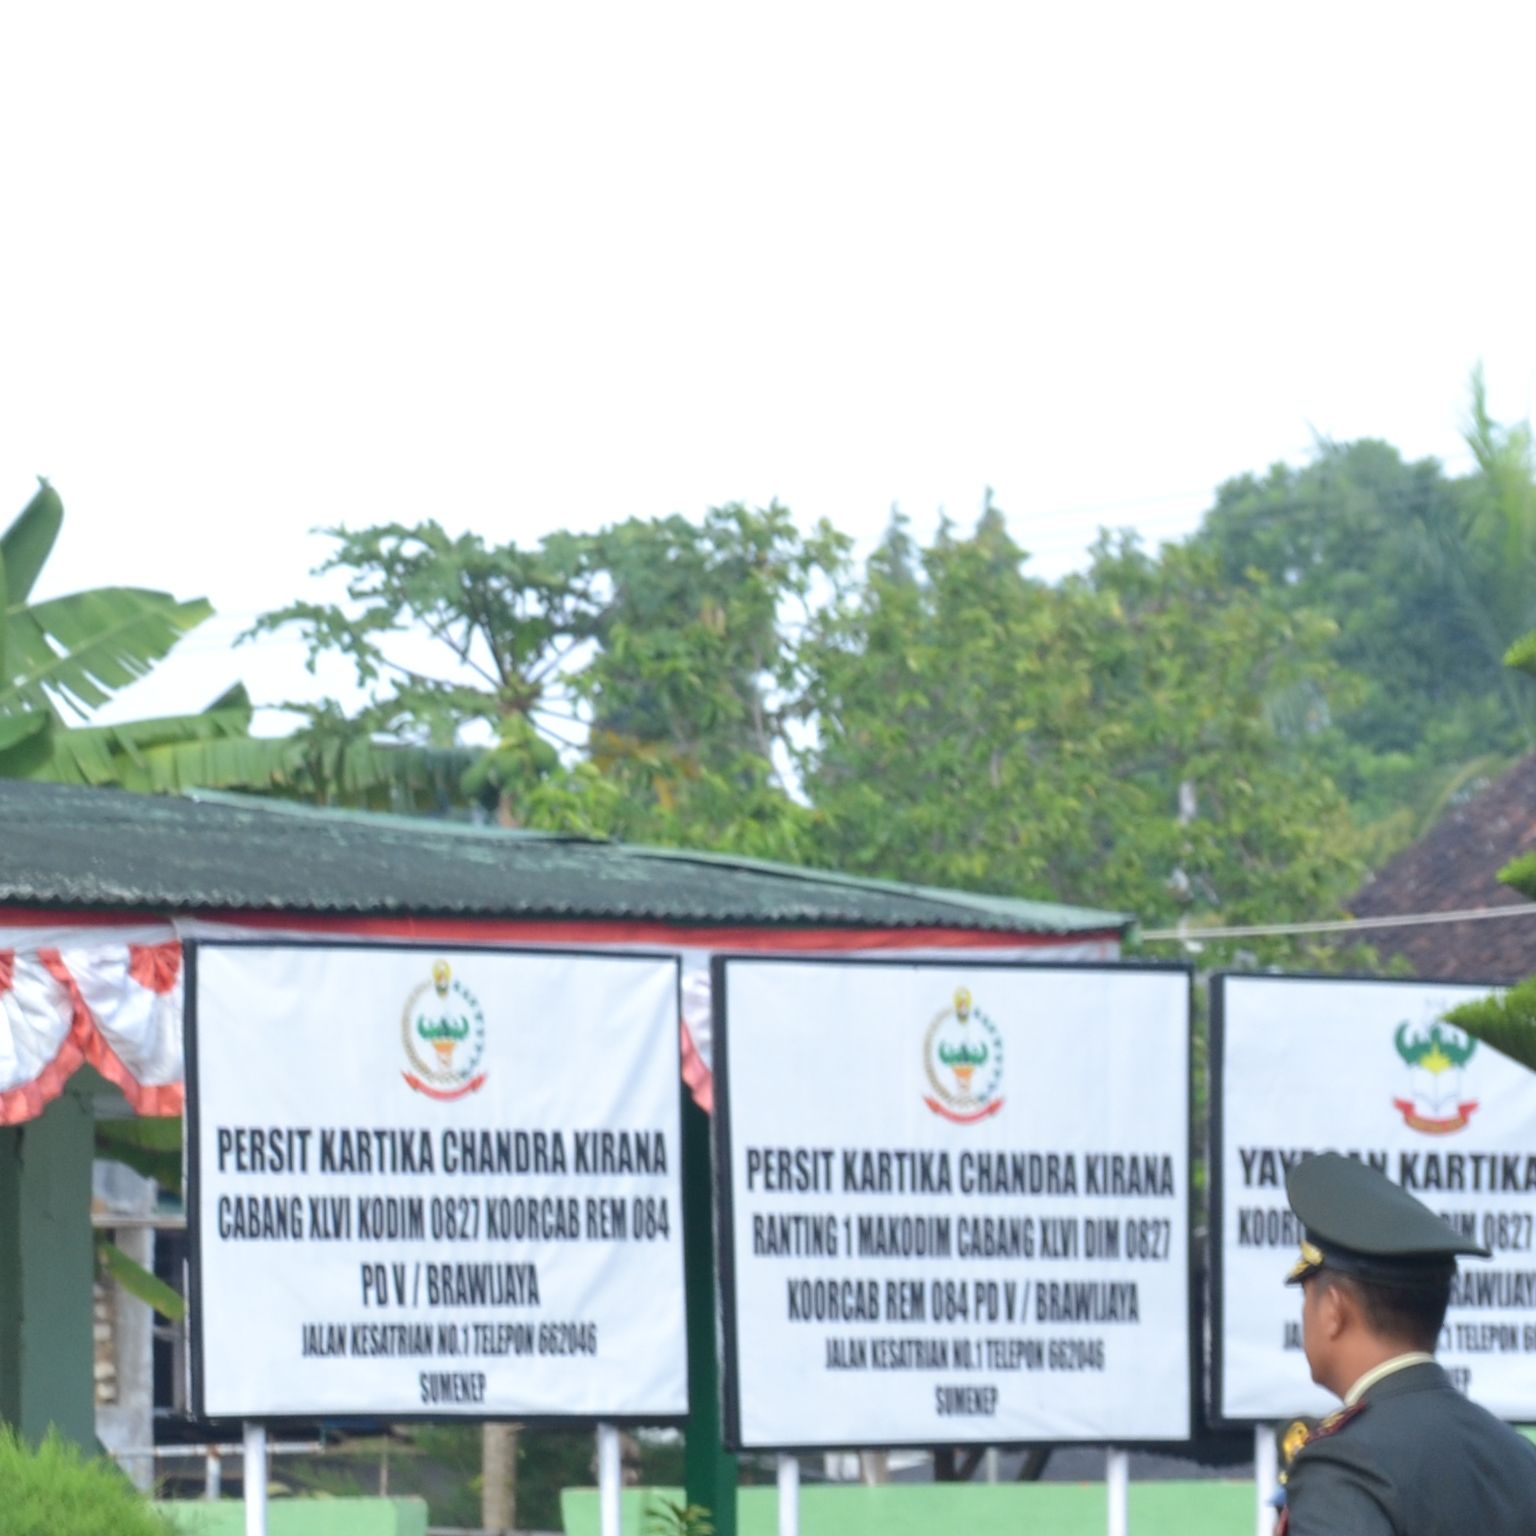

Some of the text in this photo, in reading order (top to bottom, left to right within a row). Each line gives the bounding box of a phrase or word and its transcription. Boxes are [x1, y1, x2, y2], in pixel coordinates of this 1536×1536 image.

[218, 1128, 667, 1175] PERSIT KARTIKA CHANDRA KIRANA
[747, 1148, 1174, 1196] PERSIT KARTIKA CHANDRA KIRANA
[218, 1195, 670, 1241] CABANG XLVI KODIM 0827 KOORCAB REM 084
[753, 1214, 1171, 1261] RANTING 1 MAKODIM CABANG XLVI DIM 0827
[1484, 1213, 1532, 1251] 0827
[361, 1263, 388, 1307] PD
[392, 1263, 405, 1306] V
[426, 1263, 540, 1307] BRAWIJAYA
[788, 1279, 880, 1322] KOORCAB
[886, 1280, 925, 1322] REM
[931, 1280, 969, 1323] 084
[974, 1280, 999, 1323] PD
[1004, 1281, 1016, 1322] V
[1036, 1281, 1139, 1323] BRAWIJAYA
[303, 1321, 597, 1357] JALAN KESATRIAN NO.1 TELEPON 662046
[826, 1338, 867, 1370] JALAN
[871, 1338, 949, 1370] KESATRIAN
[985, 1338, 1045, 1370] TELEPON
[1456, 1323, 1518, 1352] TELEPON
[420, 1372, 485, 1404] SUMENEP
[935, 1386, 998, 1416] SUMENEP
